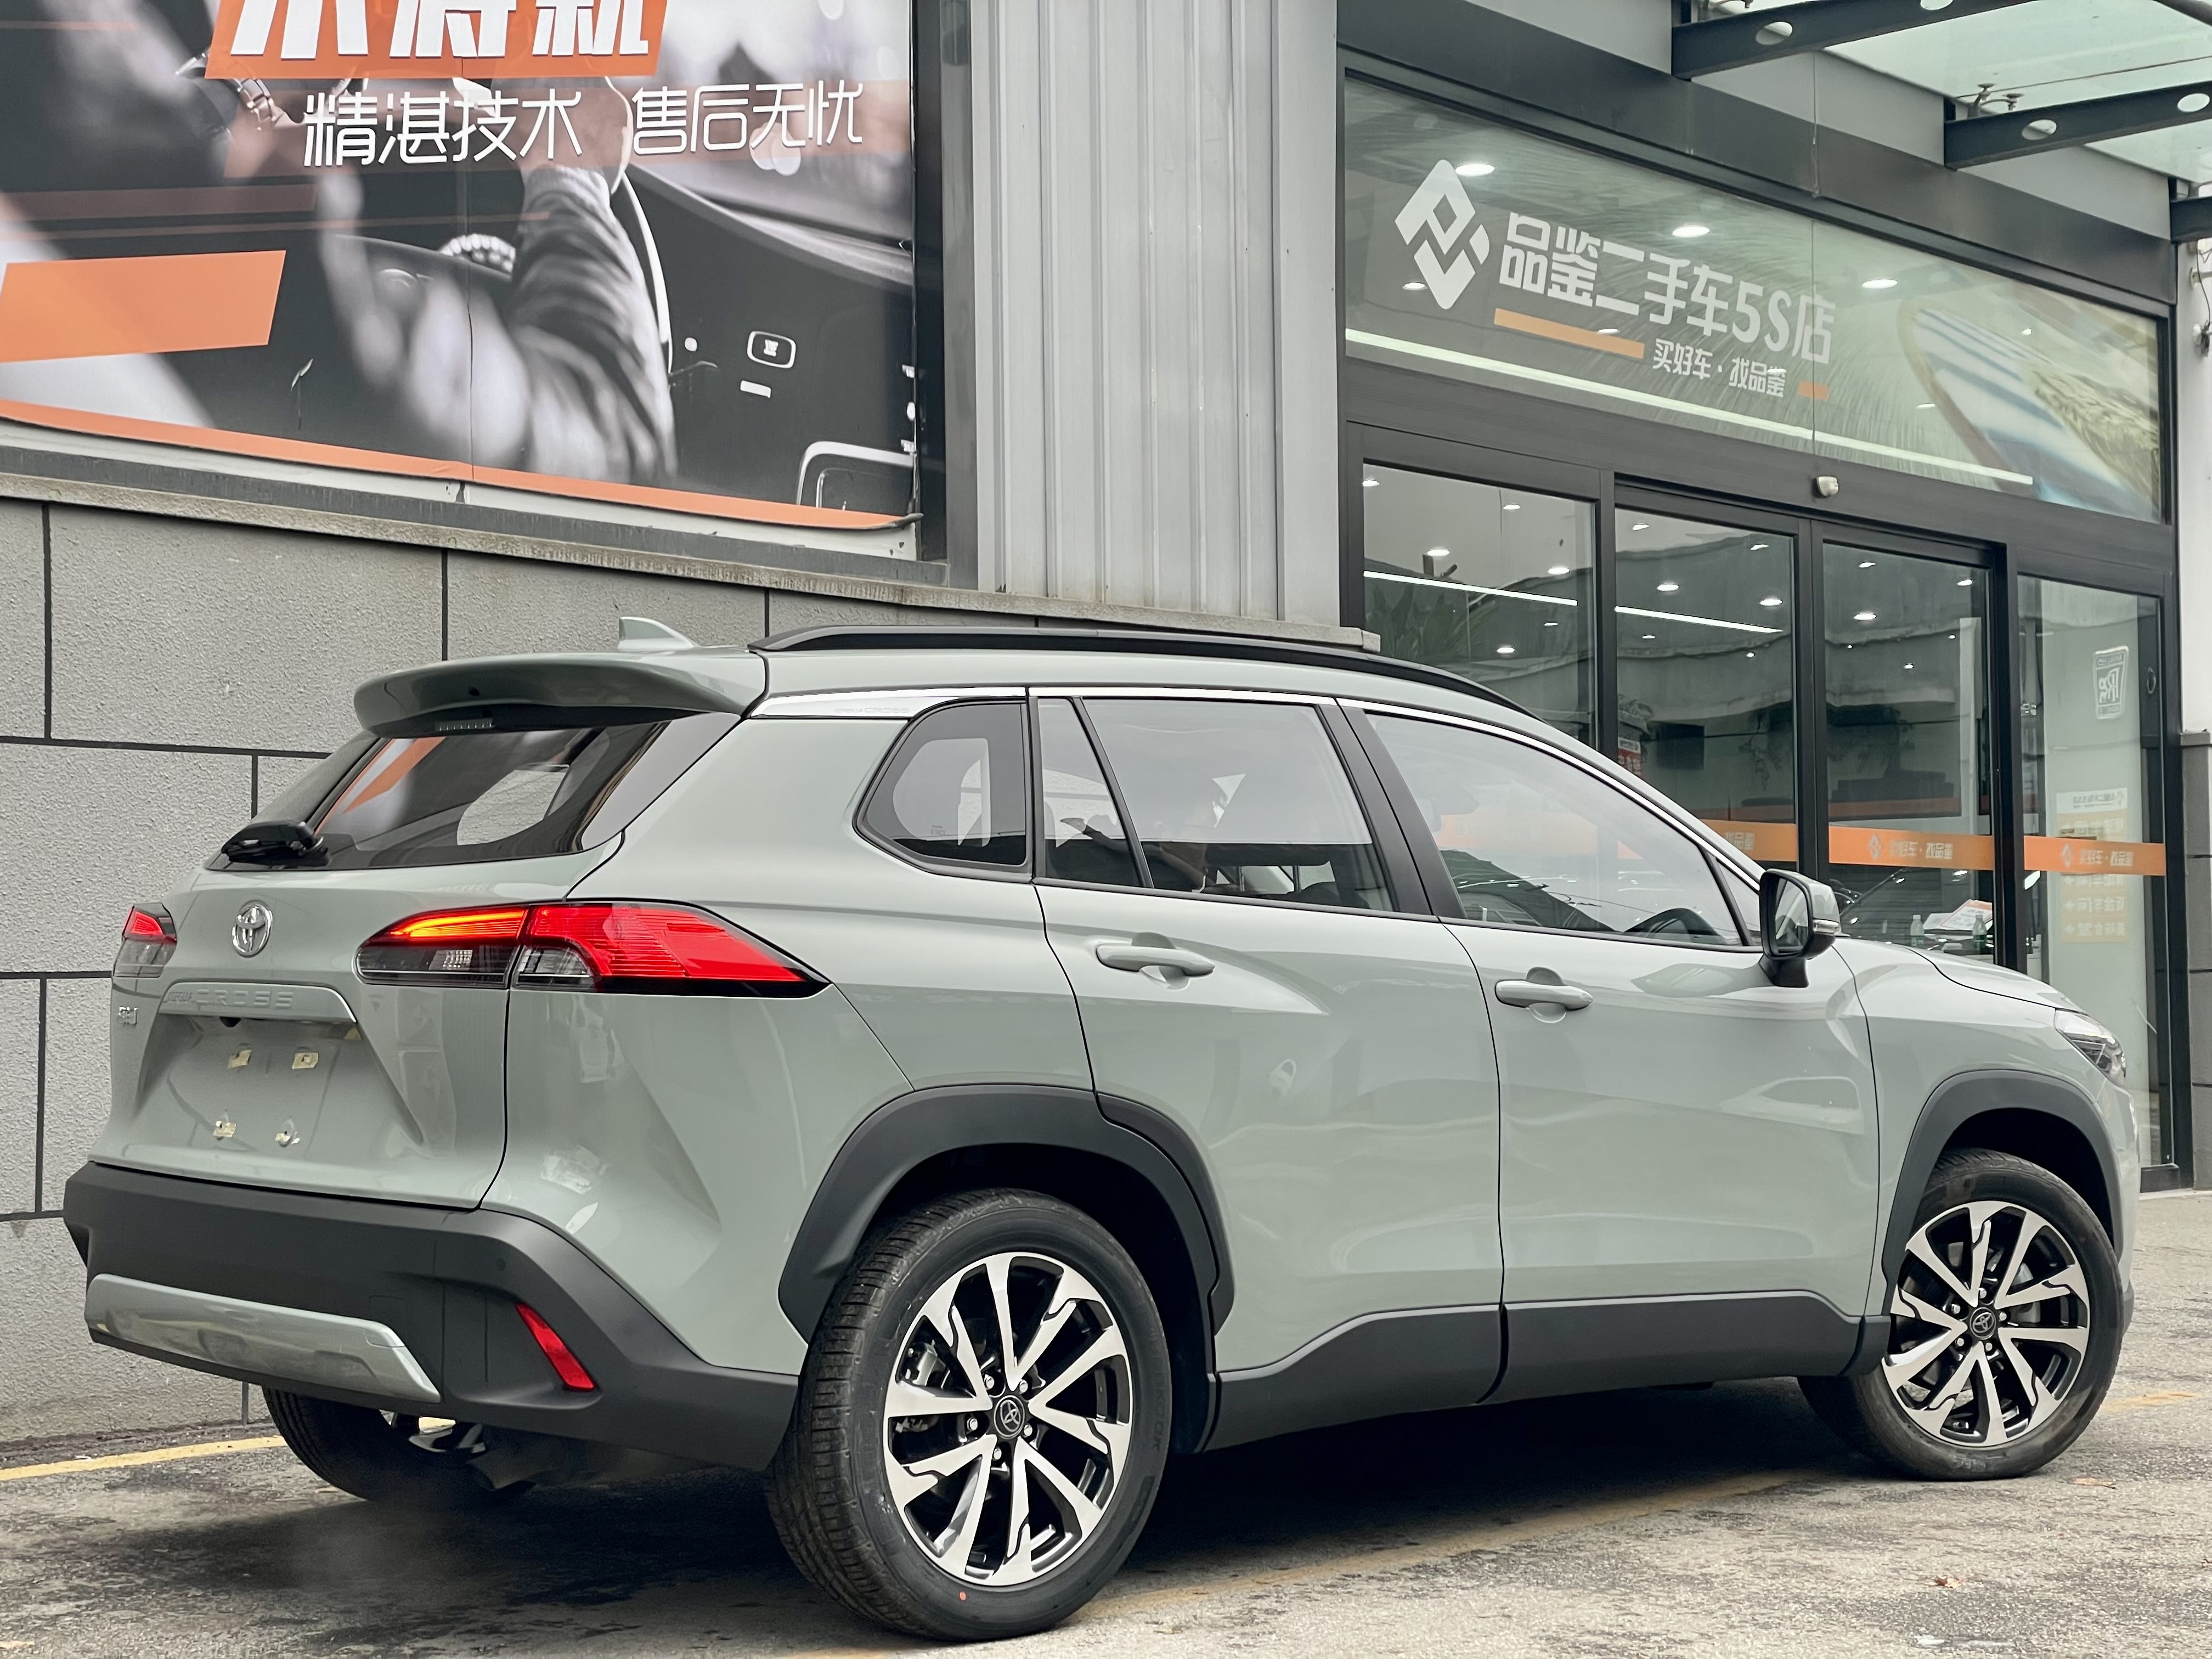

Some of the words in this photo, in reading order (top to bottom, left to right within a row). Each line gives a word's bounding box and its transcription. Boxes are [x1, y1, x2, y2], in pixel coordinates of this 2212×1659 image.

[303, 90, 582, 167] 精湛技术
[632, 80, 864, 155] 售后无忧
[1499, 212, 1836, 364] 品鉴二手车5S店
